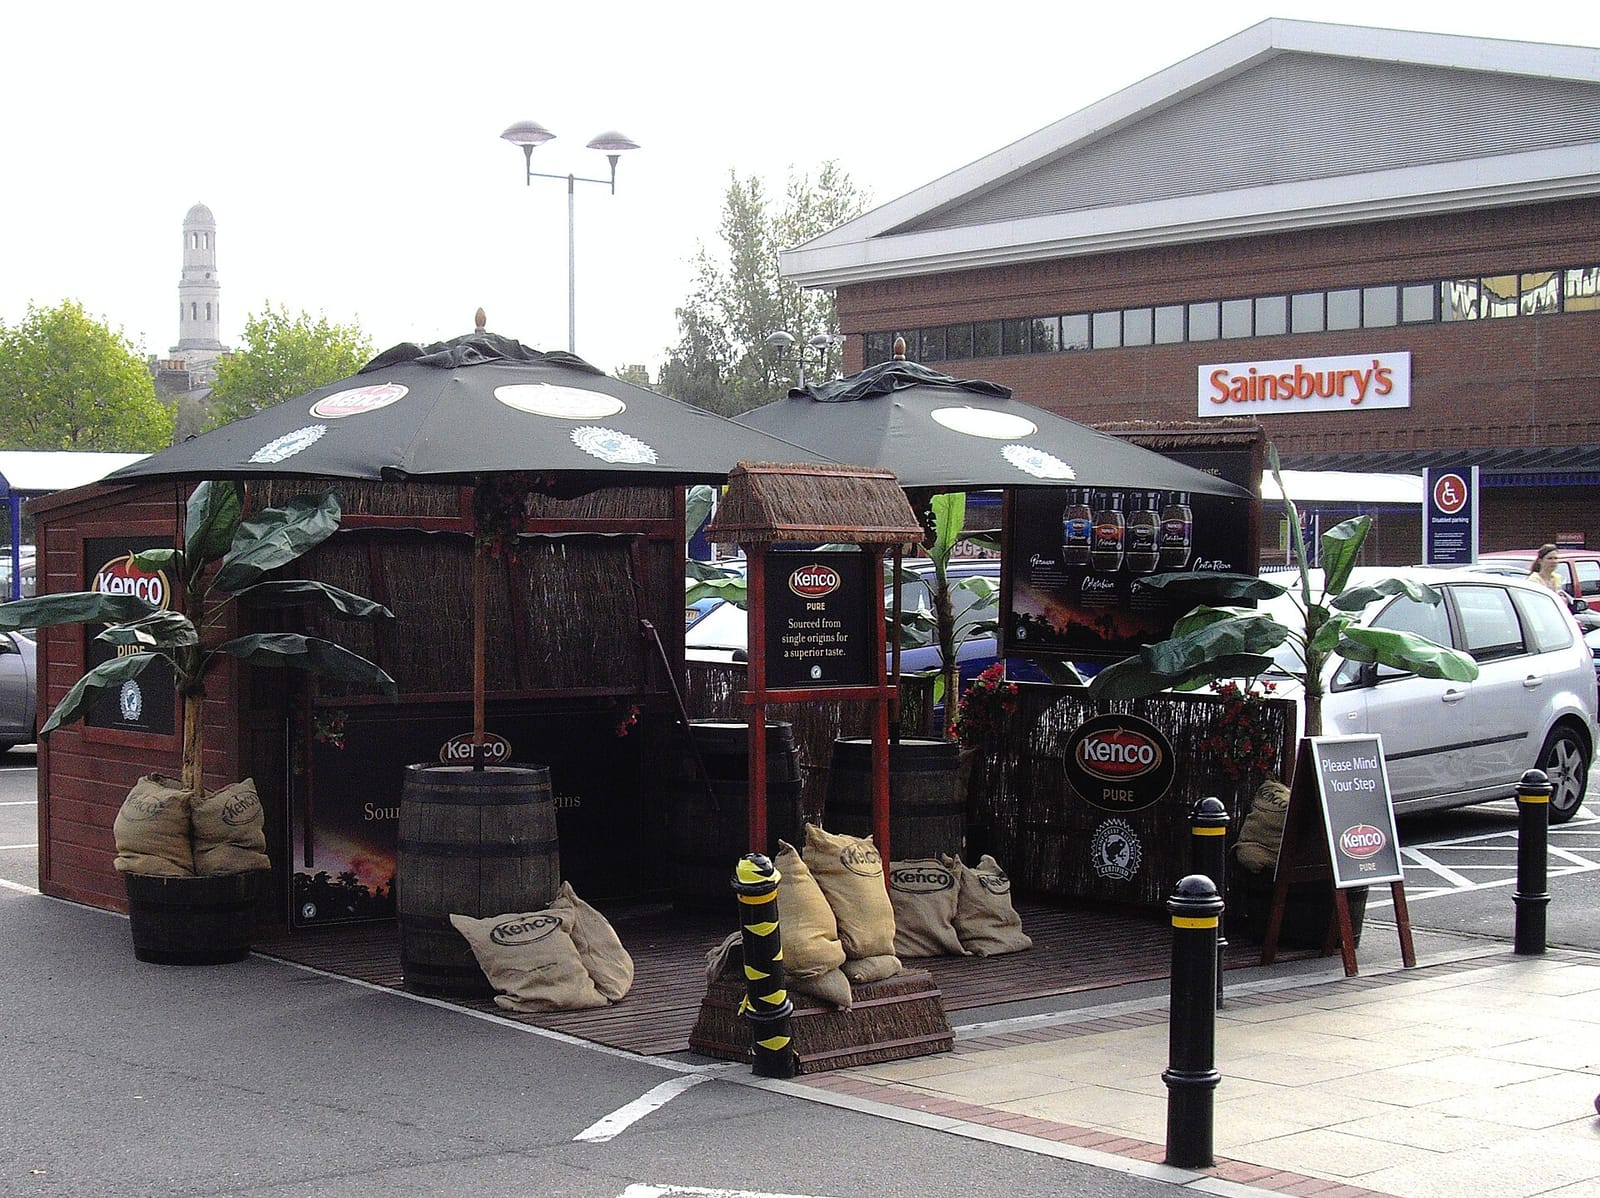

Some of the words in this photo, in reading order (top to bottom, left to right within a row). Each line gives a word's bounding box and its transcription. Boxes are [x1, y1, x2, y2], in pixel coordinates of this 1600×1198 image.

[1210, 359, 1393, 405] Sainsbury's
[794, 572, 836, 587] Kenco
[98, 572, 162, 605] Kenco
[806, 602, 826, 611] PURE
[788, 617, 821, 629] Sourced
[821, 617, 841, 629] from
[781, 633, 806, 647] single
[807, 632, 835, 646] origins
[836, 631, 849, 643] for
[783, 650, 789, 658] a
[790, 647, 824, 660] superior
[825, 647, 846, 657] taste.
[1084, 738, 1154, 765] Kenco
[1322, 758, 1352, 772] Please
[1353, 756, 1378, 770] Mind
[1331, 779, 1353, 792] Your
[1354, 778, 1376, 792] Step
[1103, 788, 1135, 802] PURE
[1342, 831, 1381, 848] Kenco
[1358, 862, 1377, 872] PURE
[893, 870, 948, 885] Kenco
[497, 917, 557, 939] Kenco
